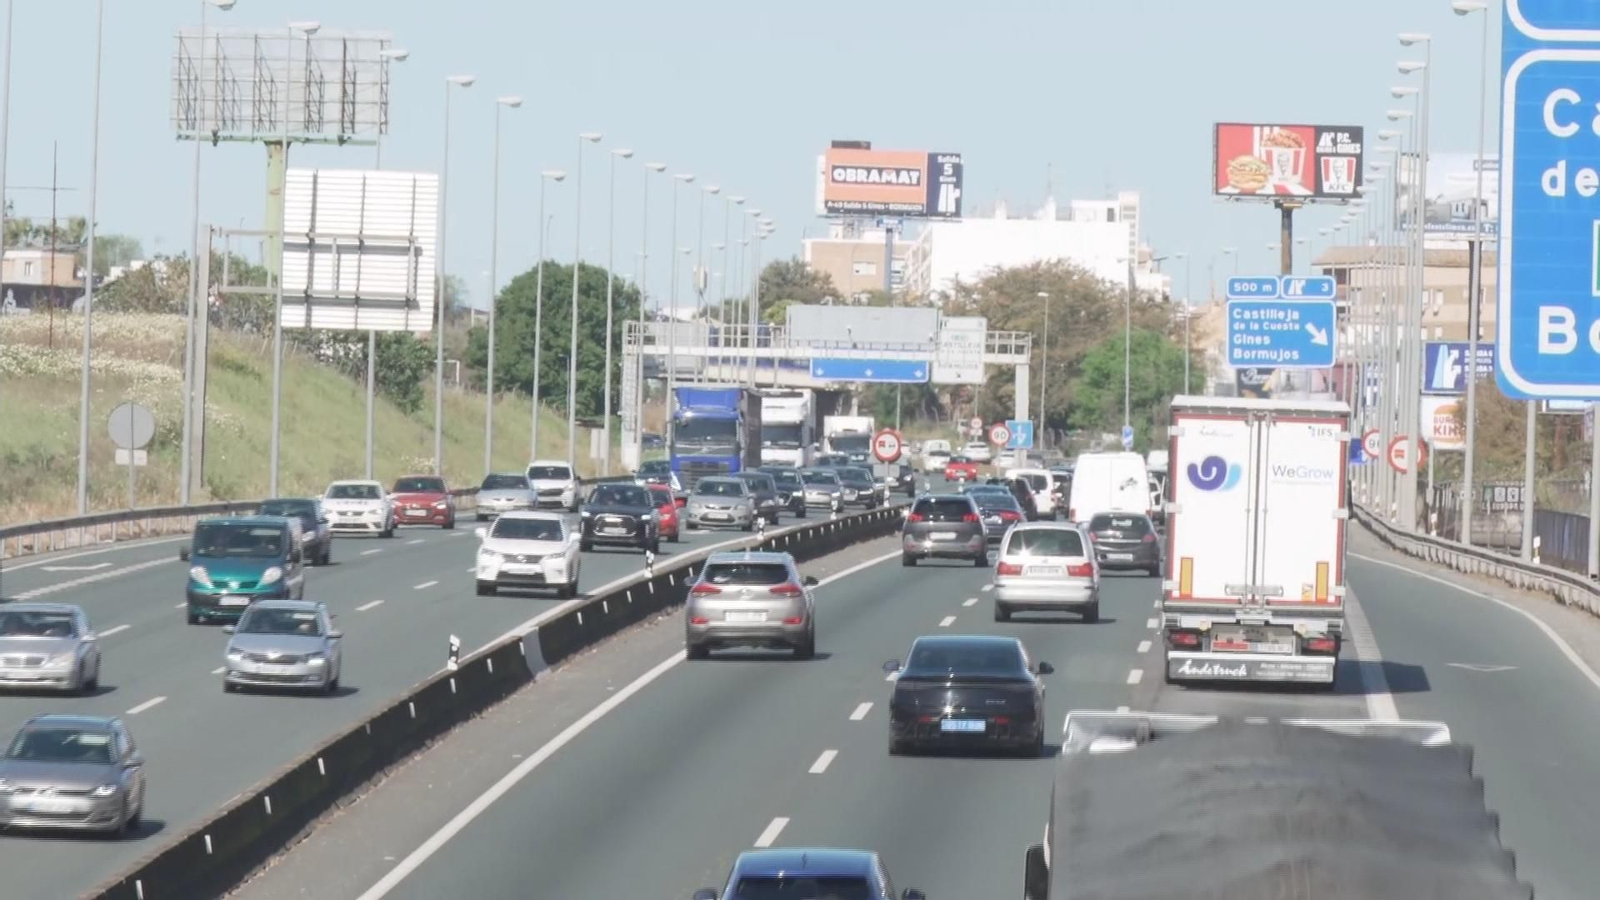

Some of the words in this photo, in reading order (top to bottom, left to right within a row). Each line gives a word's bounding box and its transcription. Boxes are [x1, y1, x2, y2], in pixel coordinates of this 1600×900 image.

[1543, 88, 1600, 138] C
[943, 163, 953, 175] 5
[832, 168, 920, 185] OBRAMAT
[1541, 160, 1600, 197] de
[1328, 183, 1348, 191] KFC
[1233, 282, 1258, 292] 500
[1262, 284, 1273, 292] m
[1321, 283, 1329, 292] 3
[1232, 308, 1300, 322] Castilleja
[1233, 321, 1246, 330] de
[1249, 321, 1260, 330] la
[1262, 321, 1300, 331] Cuesta
[1538, 306, 1600, 354] B
[1233, 333, 1271, 345] Gines
[1232, 347, 1299, 362] Bormujos
[993, 430, 1006, 440] 90
[1272, 464, 1334, 479] WeGrow
